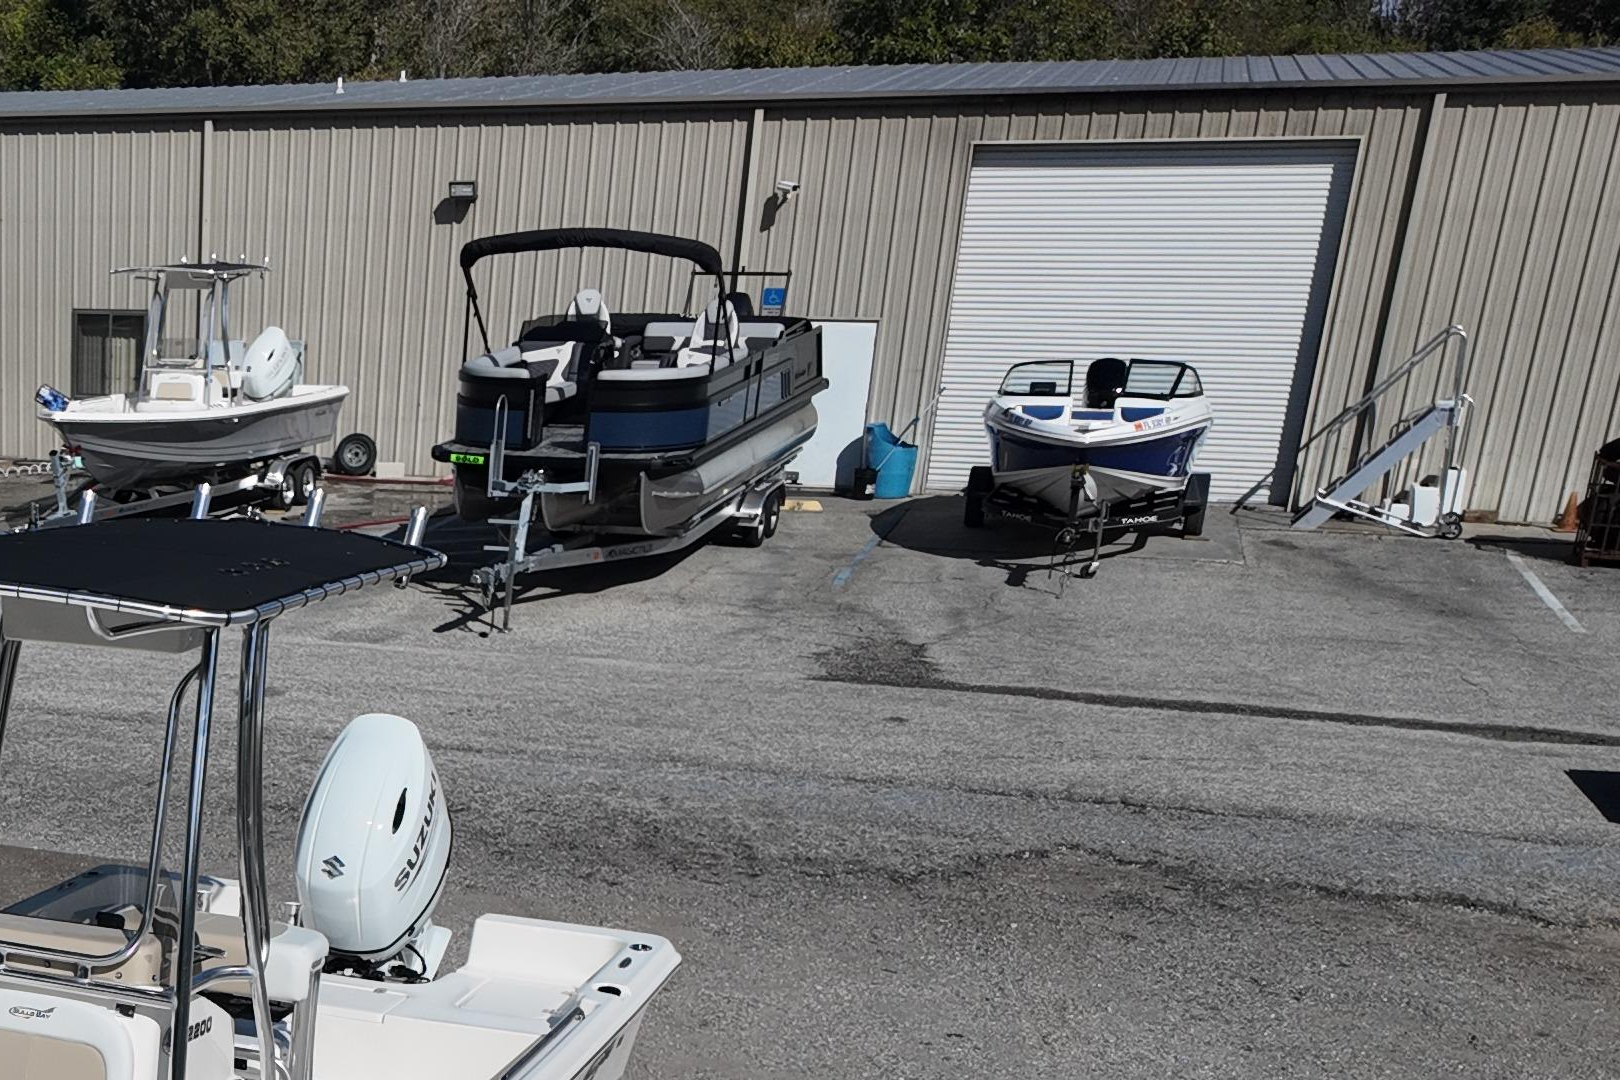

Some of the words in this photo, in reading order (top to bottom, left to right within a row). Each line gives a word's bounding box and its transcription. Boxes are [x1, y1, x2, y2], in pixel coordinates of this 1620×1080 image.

[1001, 510, 1032, 521] TAHOE
[1121, 515, 1158, 524] TAHOE
[394, 770, 437, 892] SUZUKI
[187, 1015, 213, 1042] 2200
